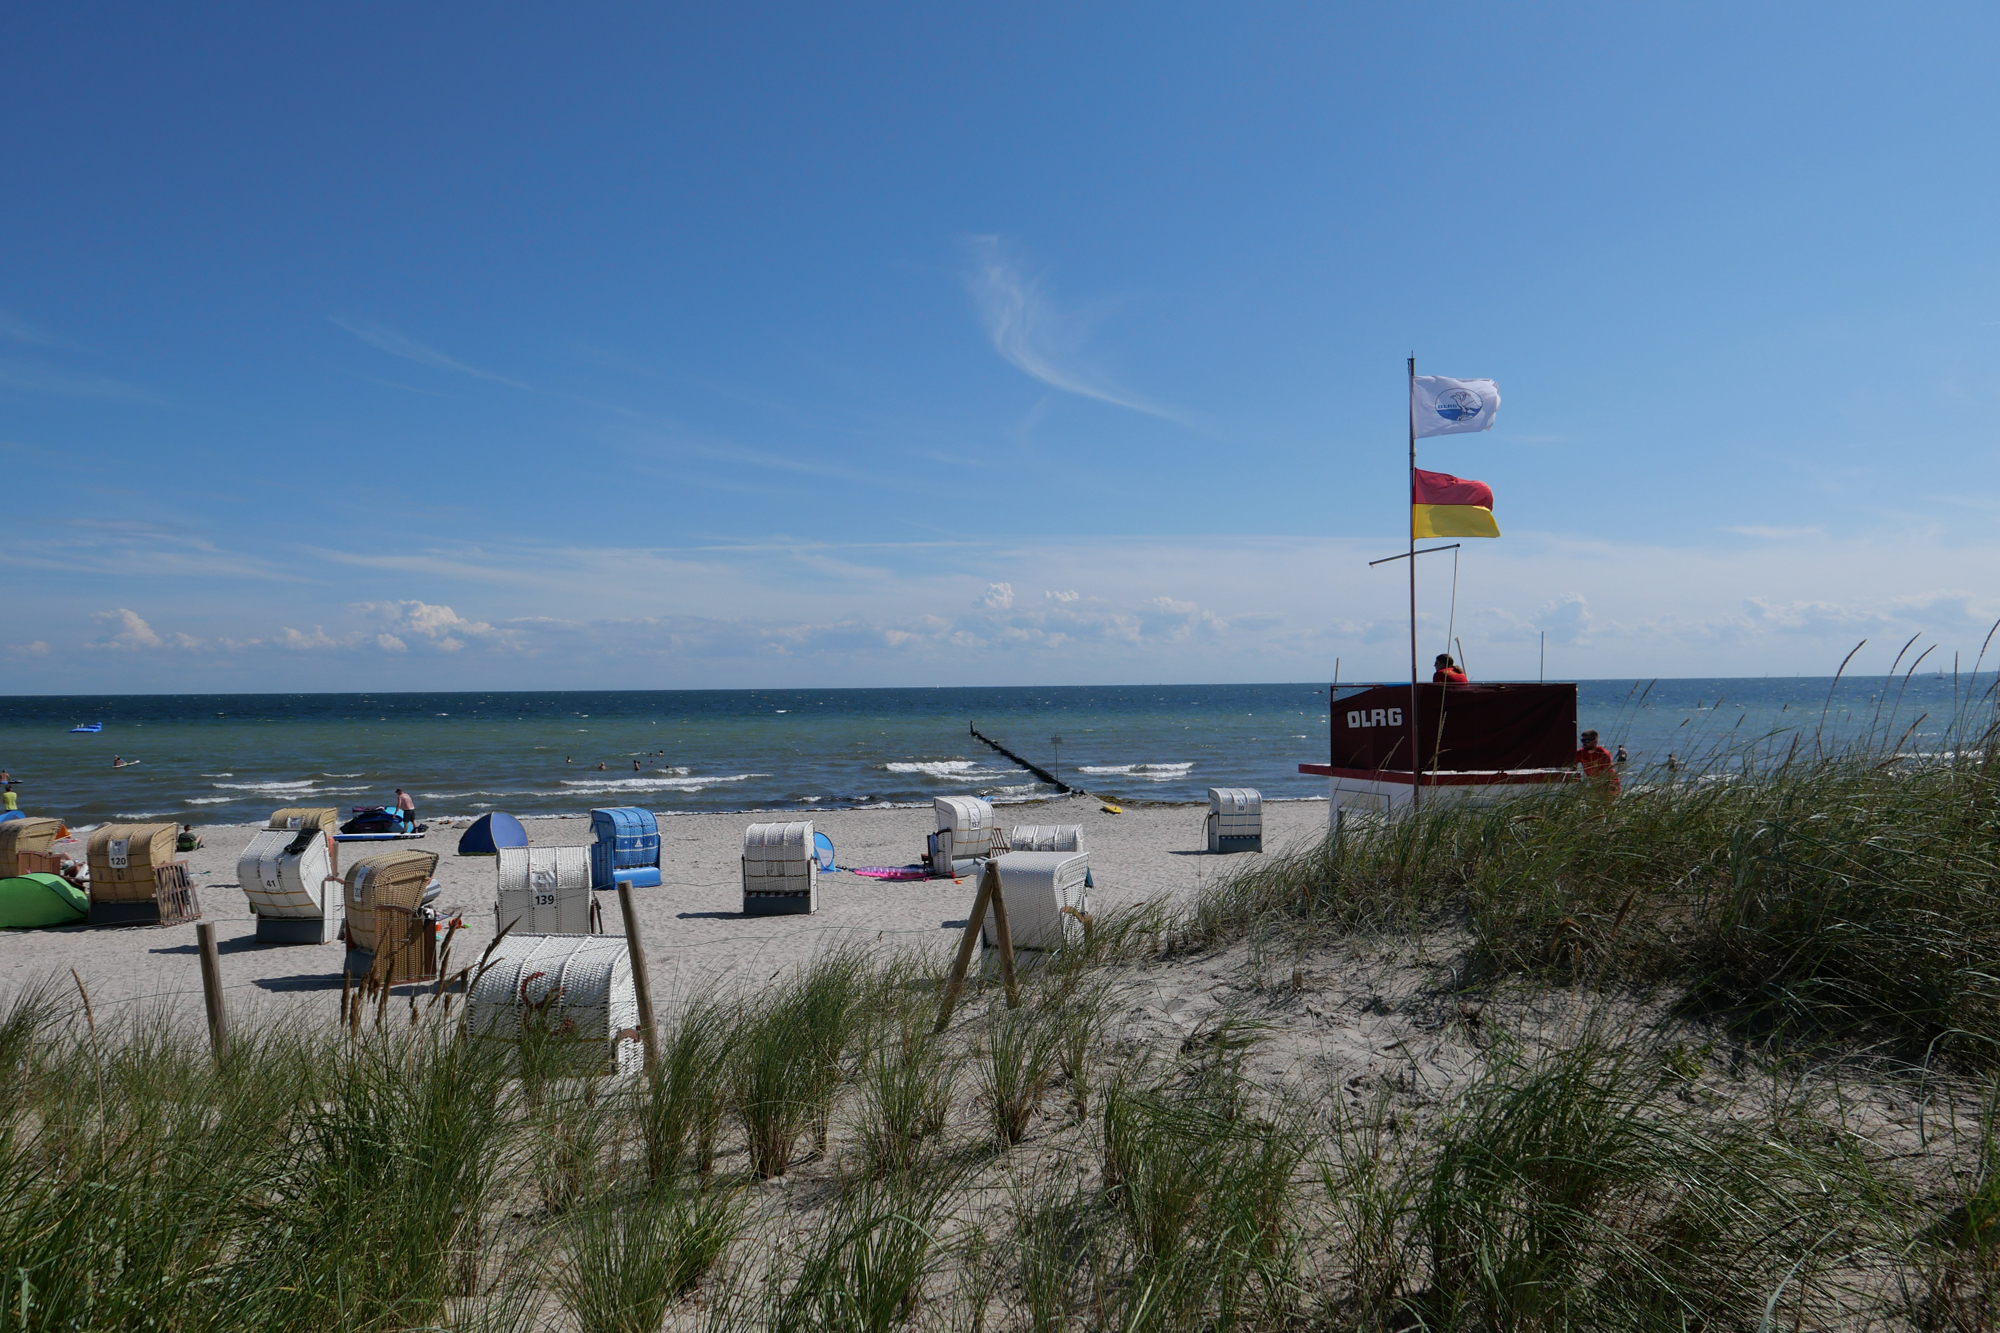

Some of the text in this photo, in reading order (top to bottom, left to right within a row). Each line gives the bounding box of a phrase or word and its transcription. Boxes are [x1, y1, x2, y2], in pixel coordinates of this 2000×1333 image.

[1347, 708, 1402, 728] DLRG
[111, 857, 126, 865] 120
[535, 894, 555, 905] 139
